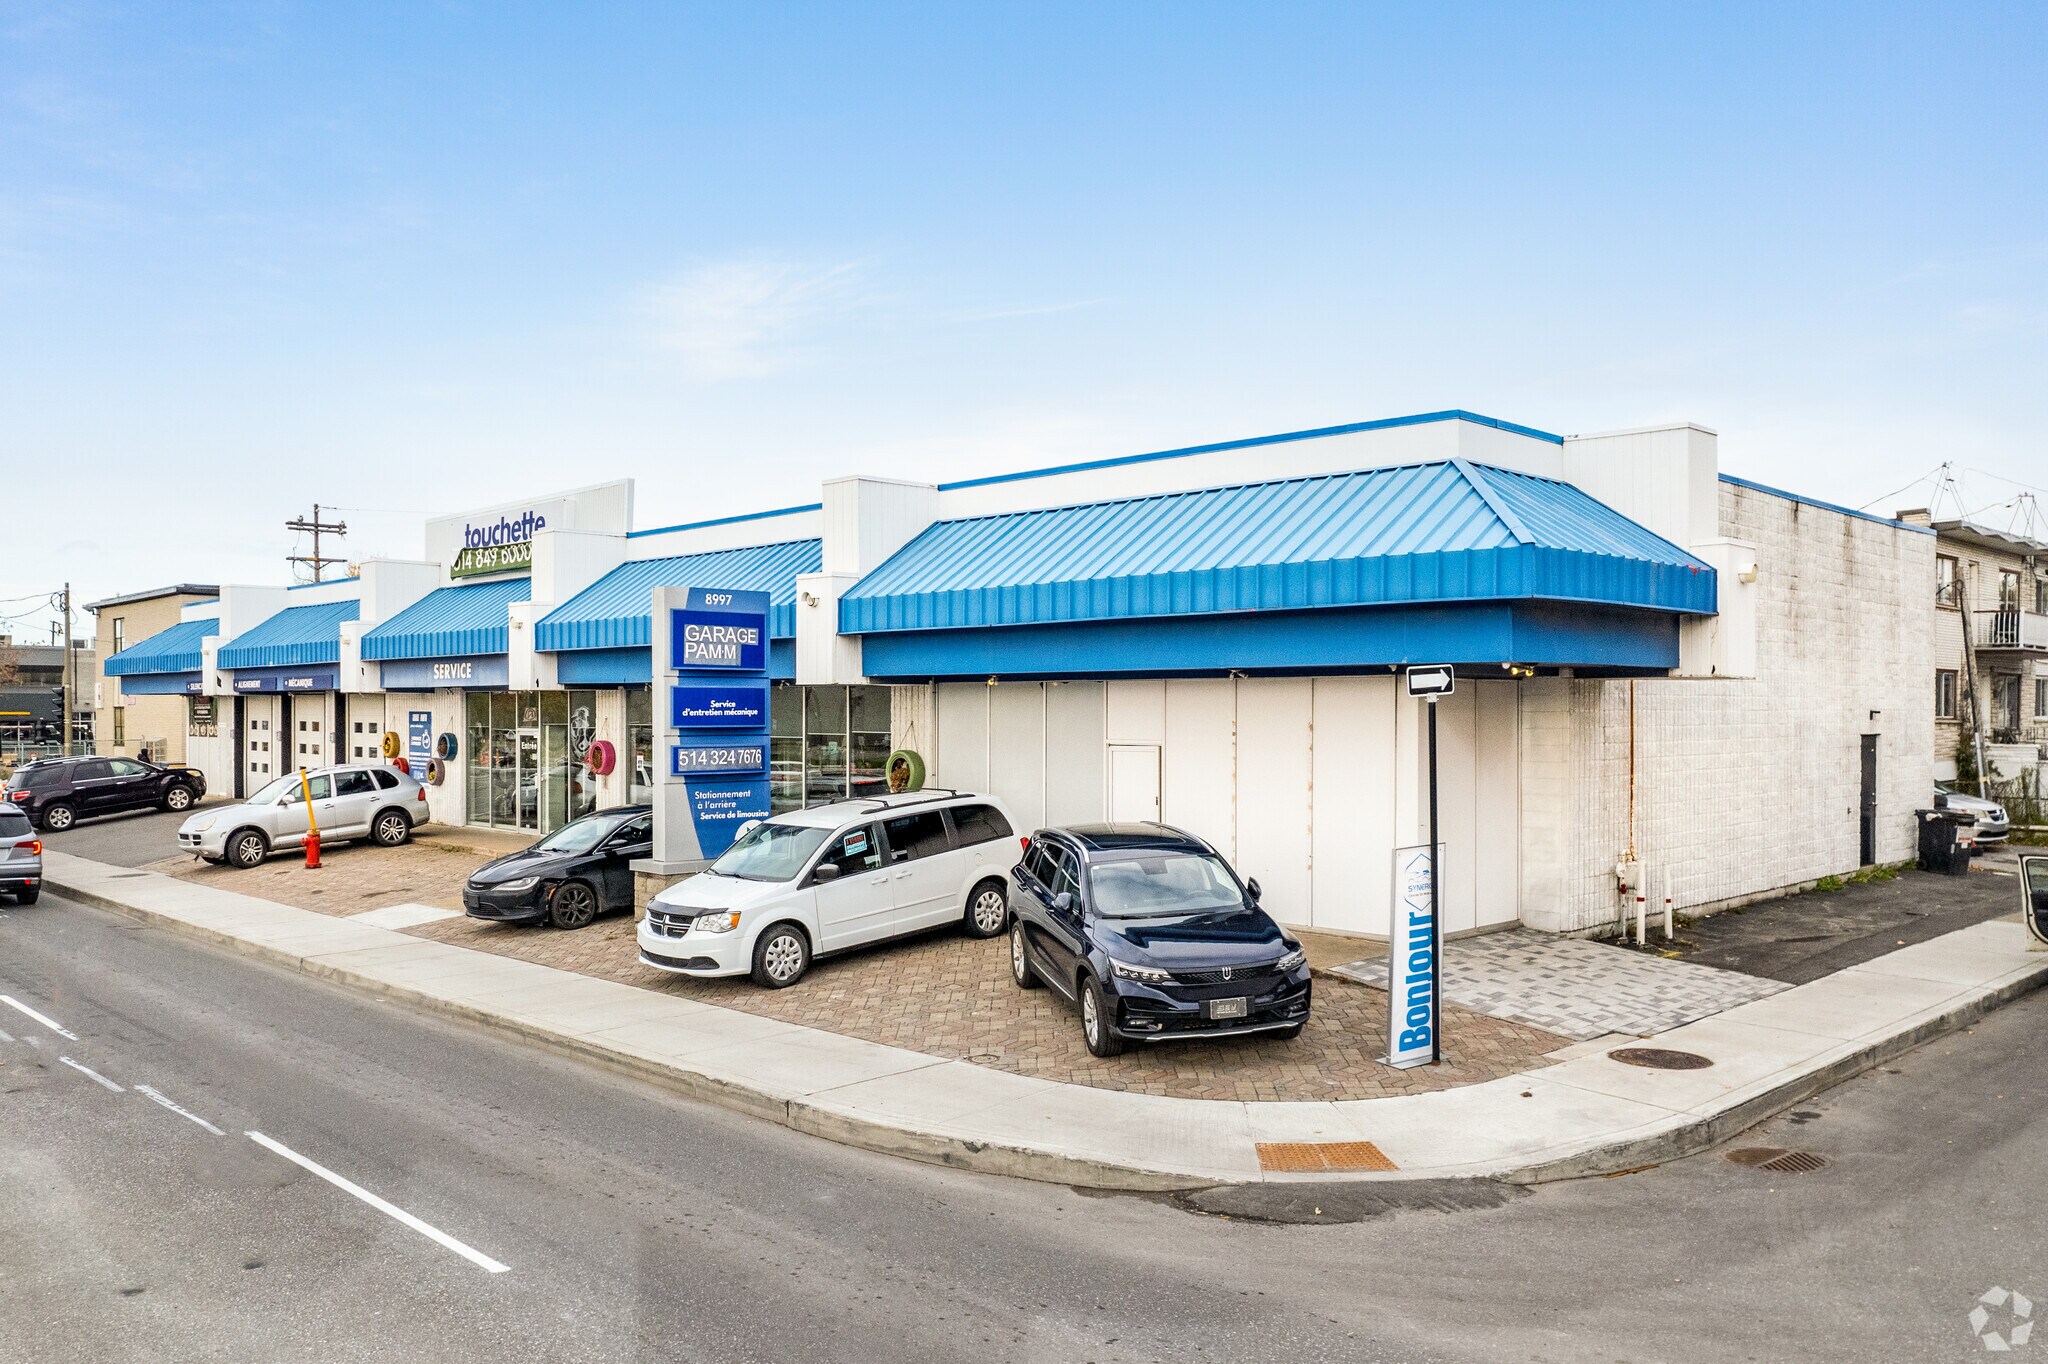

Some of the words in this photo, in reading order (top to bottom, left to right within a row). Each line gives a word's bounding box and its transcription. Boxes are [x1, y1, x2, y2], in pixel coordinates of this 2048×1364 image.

[464, 510, 546, 548] touchette
[475, 547, 498, 567] 849
[705, 593, 733, 606] 8997
[684, 624, 758, 644] GARAGE
[433, 662, 472, 680] SERVICE
[288, 677, 313, 689] MÉCANIQUE
[710, 700, 736, 709] Service
[682, 708, 723, 717] d'entretien
[723, 707, 759, 718] mécanique
[679, 750, 708, 766] 514
[710, 750, 735, 765] 324
[737, 749, 762, 764] 7676
[694, 790, 751, 800] Stationnement
[697, 801, 703, 809] à
[704, 800, 737, 809] l'arrière
[700, 812, 726, 820] Service
[726, 811, 736, 819] de
[736, 809, 769, 819] limousine
[1398, 911, 1433, 1053] Bonjour
